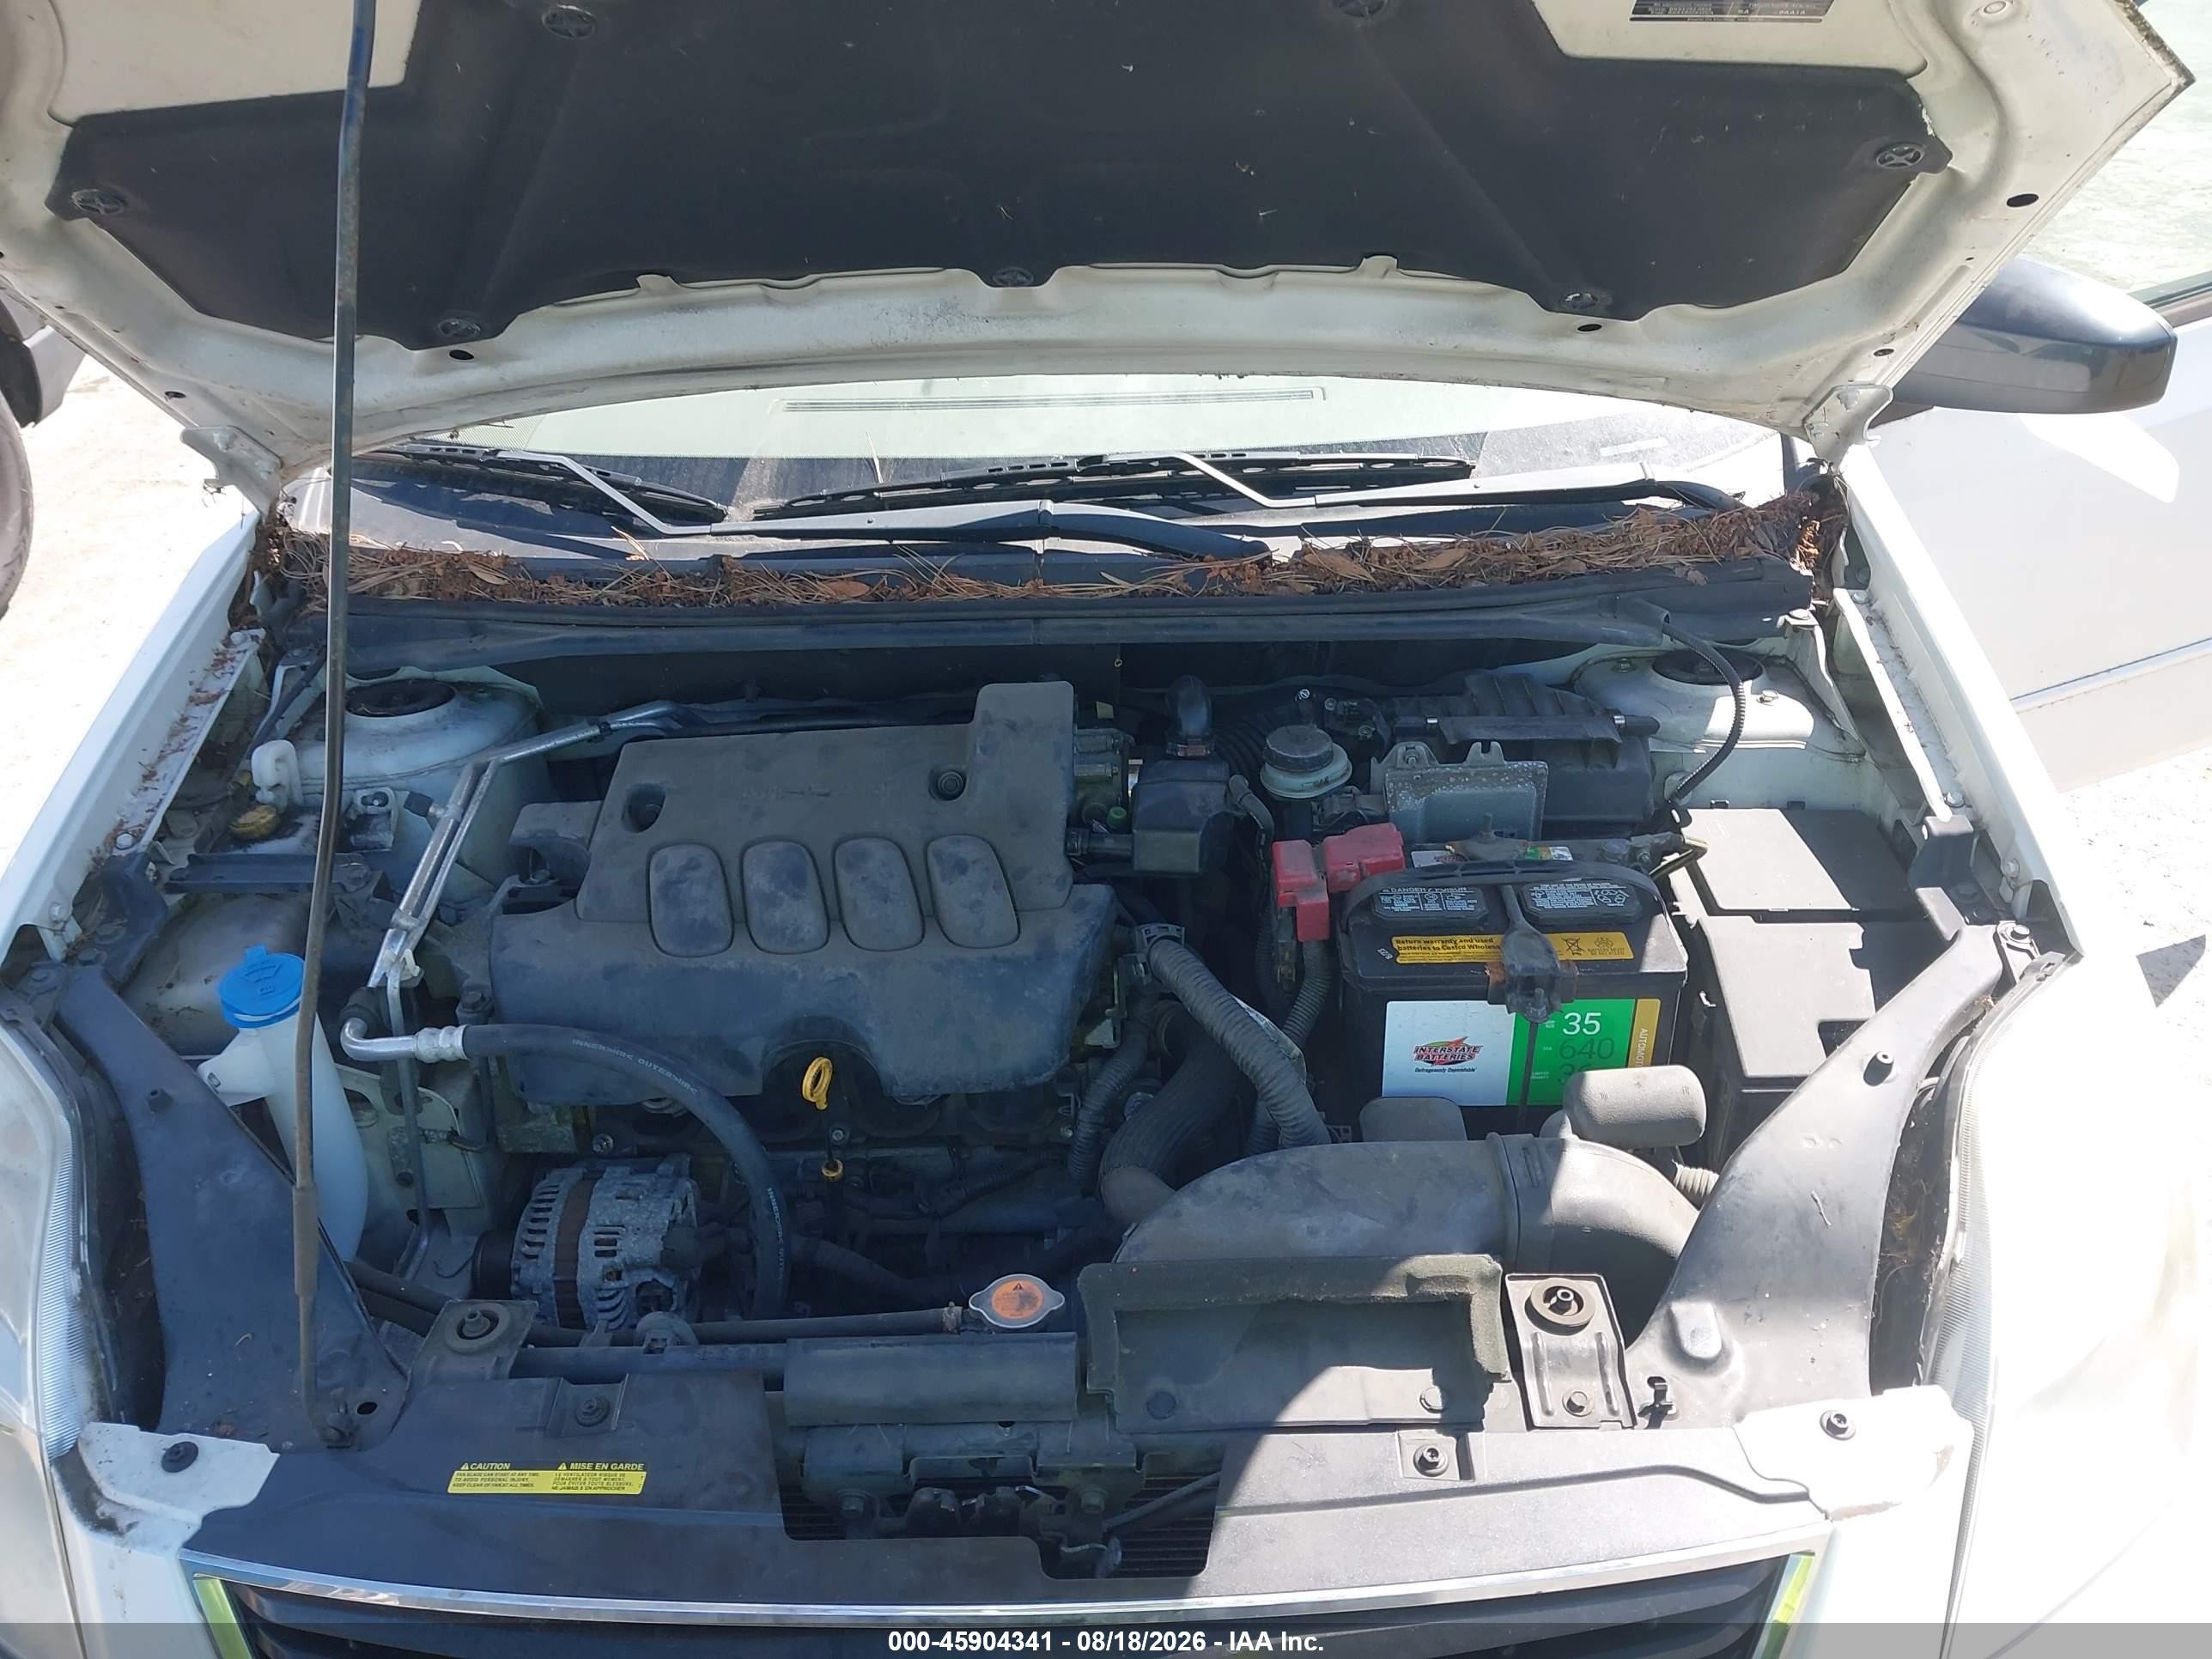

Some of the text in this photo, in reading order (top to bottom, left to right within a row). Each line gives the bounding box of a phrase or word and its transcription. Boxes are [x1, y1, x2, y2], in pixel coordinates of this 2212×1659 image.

[1563, 1012, 1601, 1036] 35
[1414, 1045, 1482, 1054] INTERSTATE
[1559, 1037, 1614, 1060] 640
